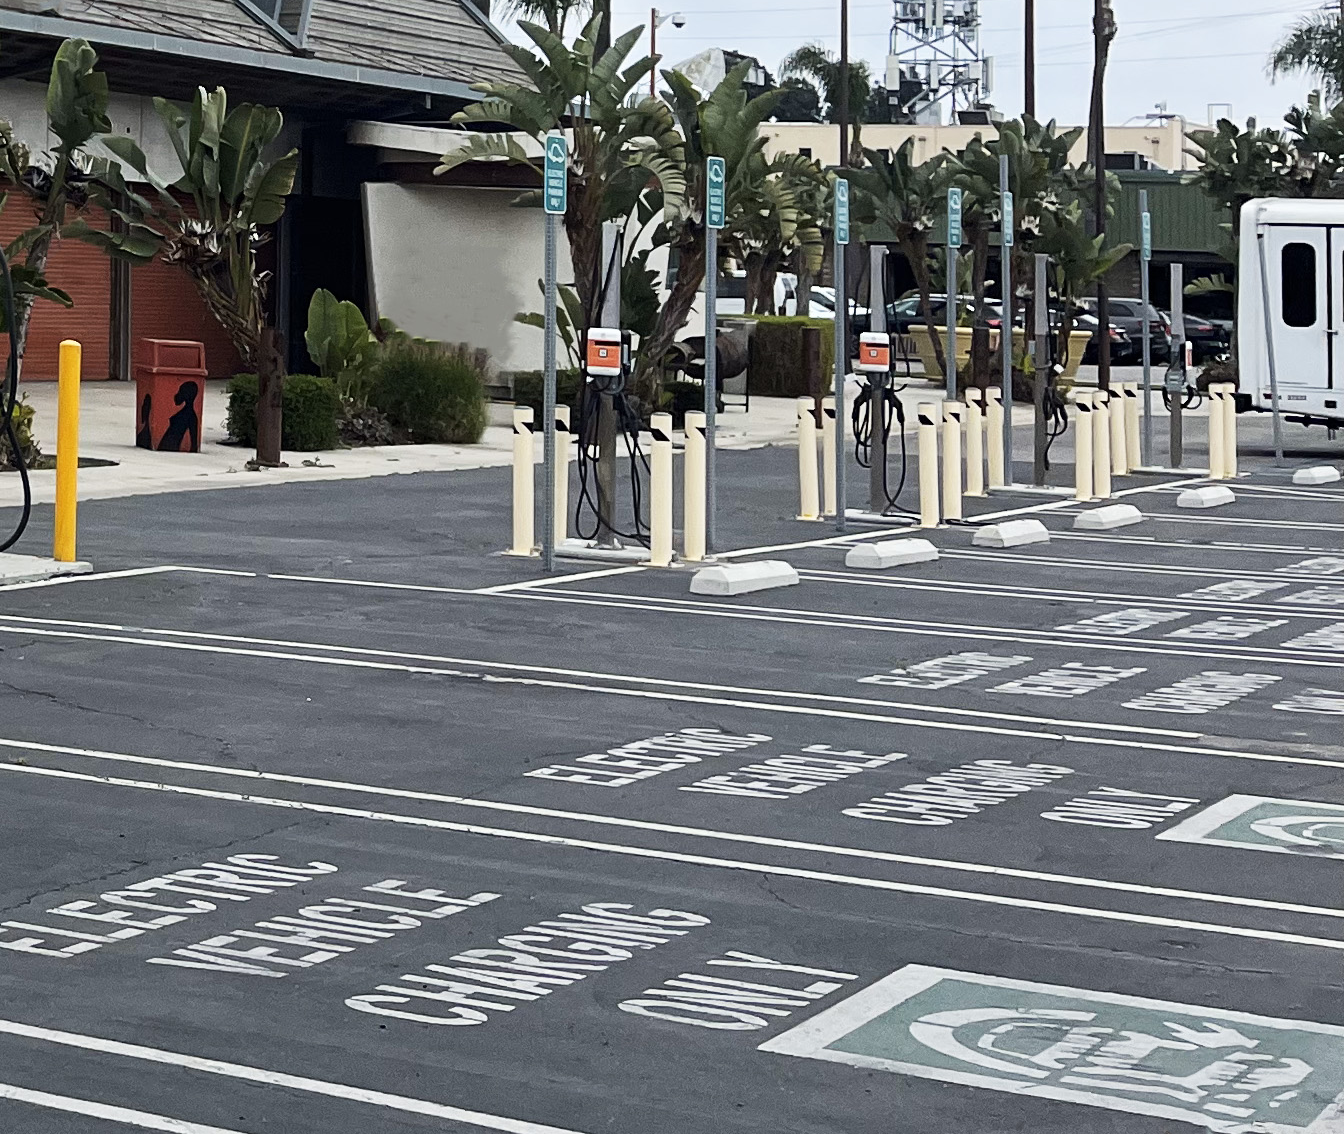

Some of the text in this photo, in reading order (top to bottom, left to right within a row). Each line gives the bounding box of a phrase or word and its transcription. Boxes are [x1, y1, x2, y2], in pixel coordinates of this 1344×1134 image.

[523, 727, 772, 787] ELECTRIC
[678, 744, 908, 799] VEHICLE
[841, 759, 1075, 826] CHARGING
[1039, 786, 1201, 829] ONLY
[145, 879, 504, 978] VEHICLE
[343, 902, 712, 1026] CHARGING
[617, 950, 860, 1031] ONLY
